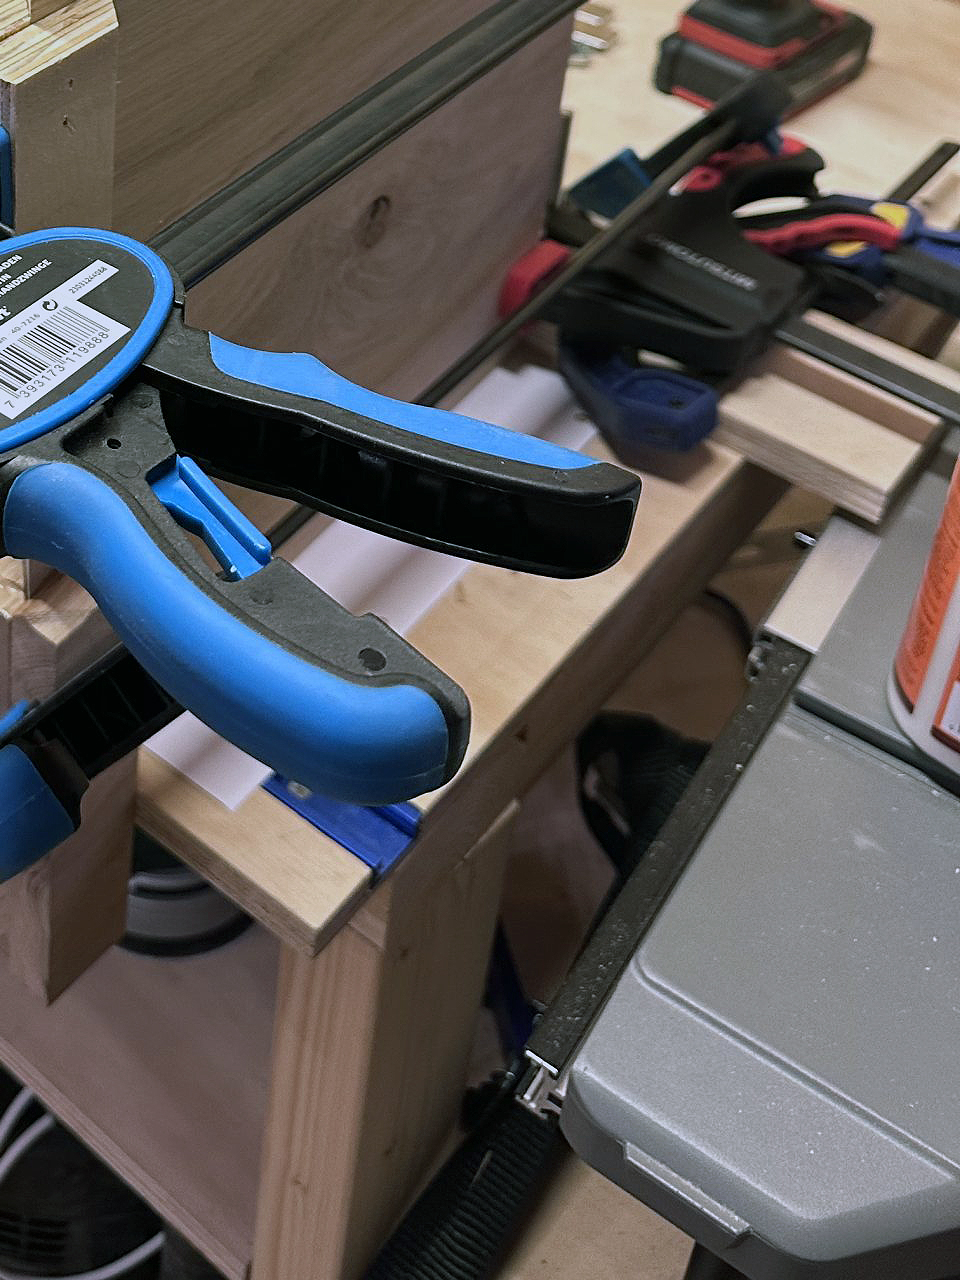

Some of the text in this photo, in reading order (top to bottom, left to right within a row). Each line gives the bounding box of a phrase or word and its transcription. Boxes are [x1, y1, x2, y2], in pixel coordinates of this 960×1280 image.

[4, 331, 110, 410] 7 393173 119888
